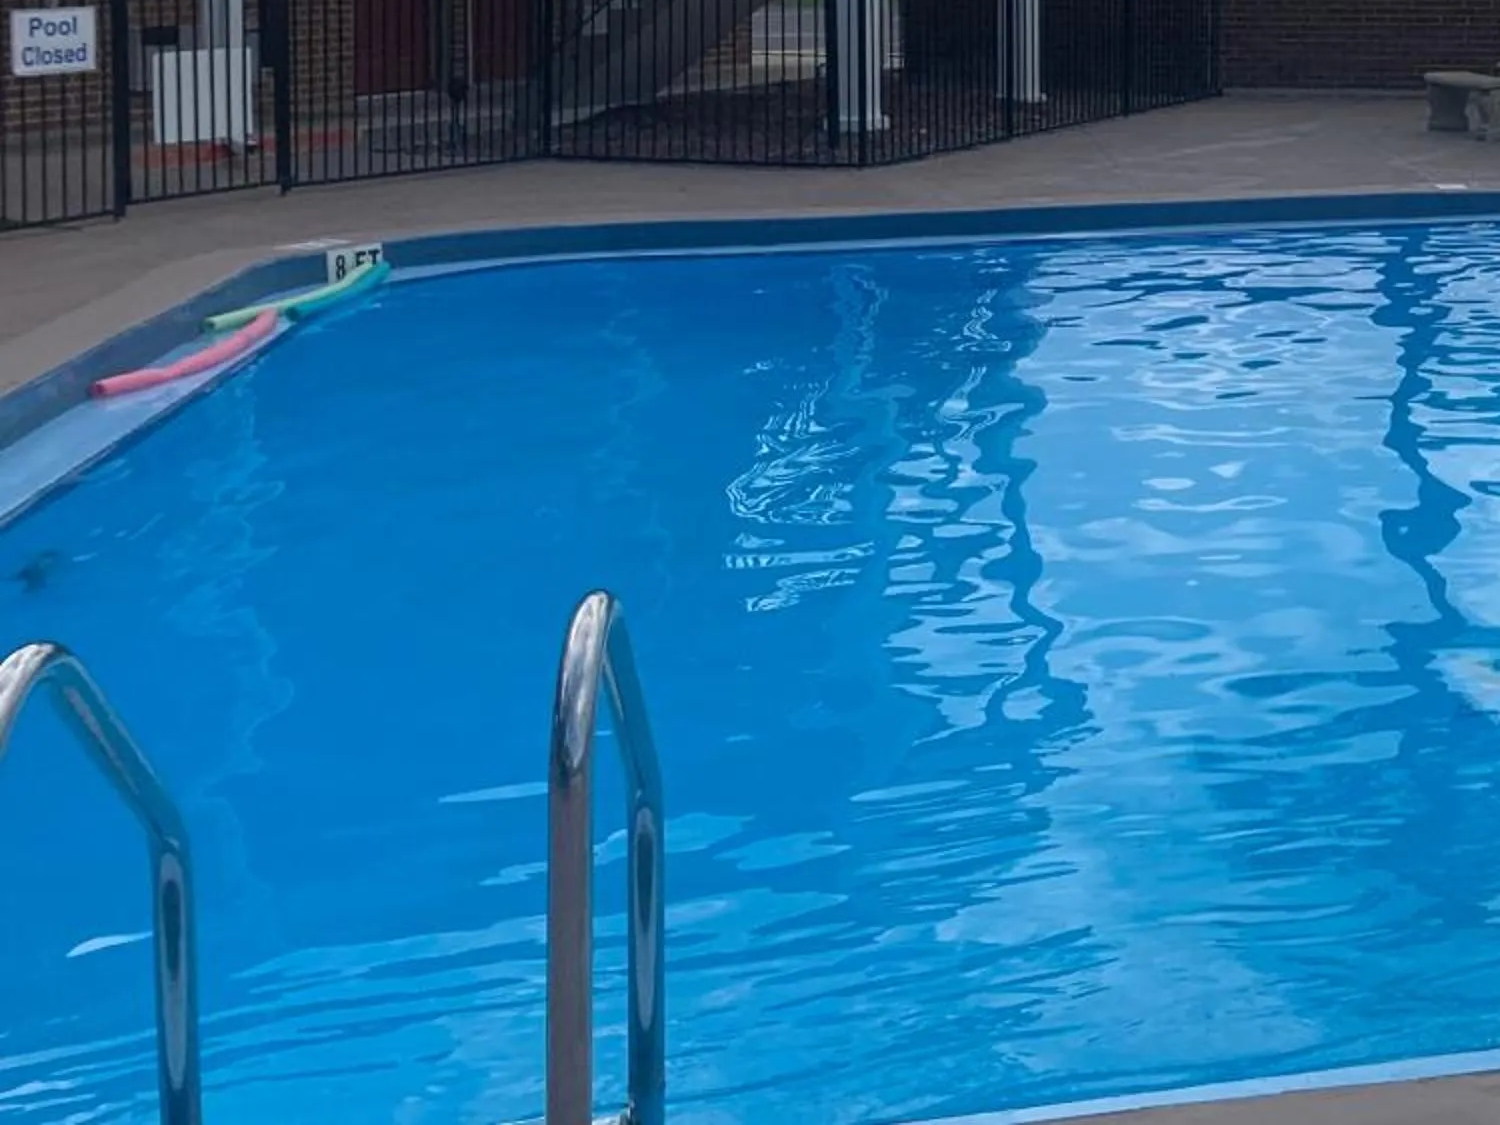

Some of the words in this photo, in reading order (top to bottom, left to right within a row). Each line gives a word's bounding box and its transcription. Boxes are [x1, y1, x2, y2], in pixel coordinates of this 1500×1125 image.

[29, 16, 77, 37] Pool
[22, 43, 87, 66] Closed
[335, 254, 346, 280] 8
